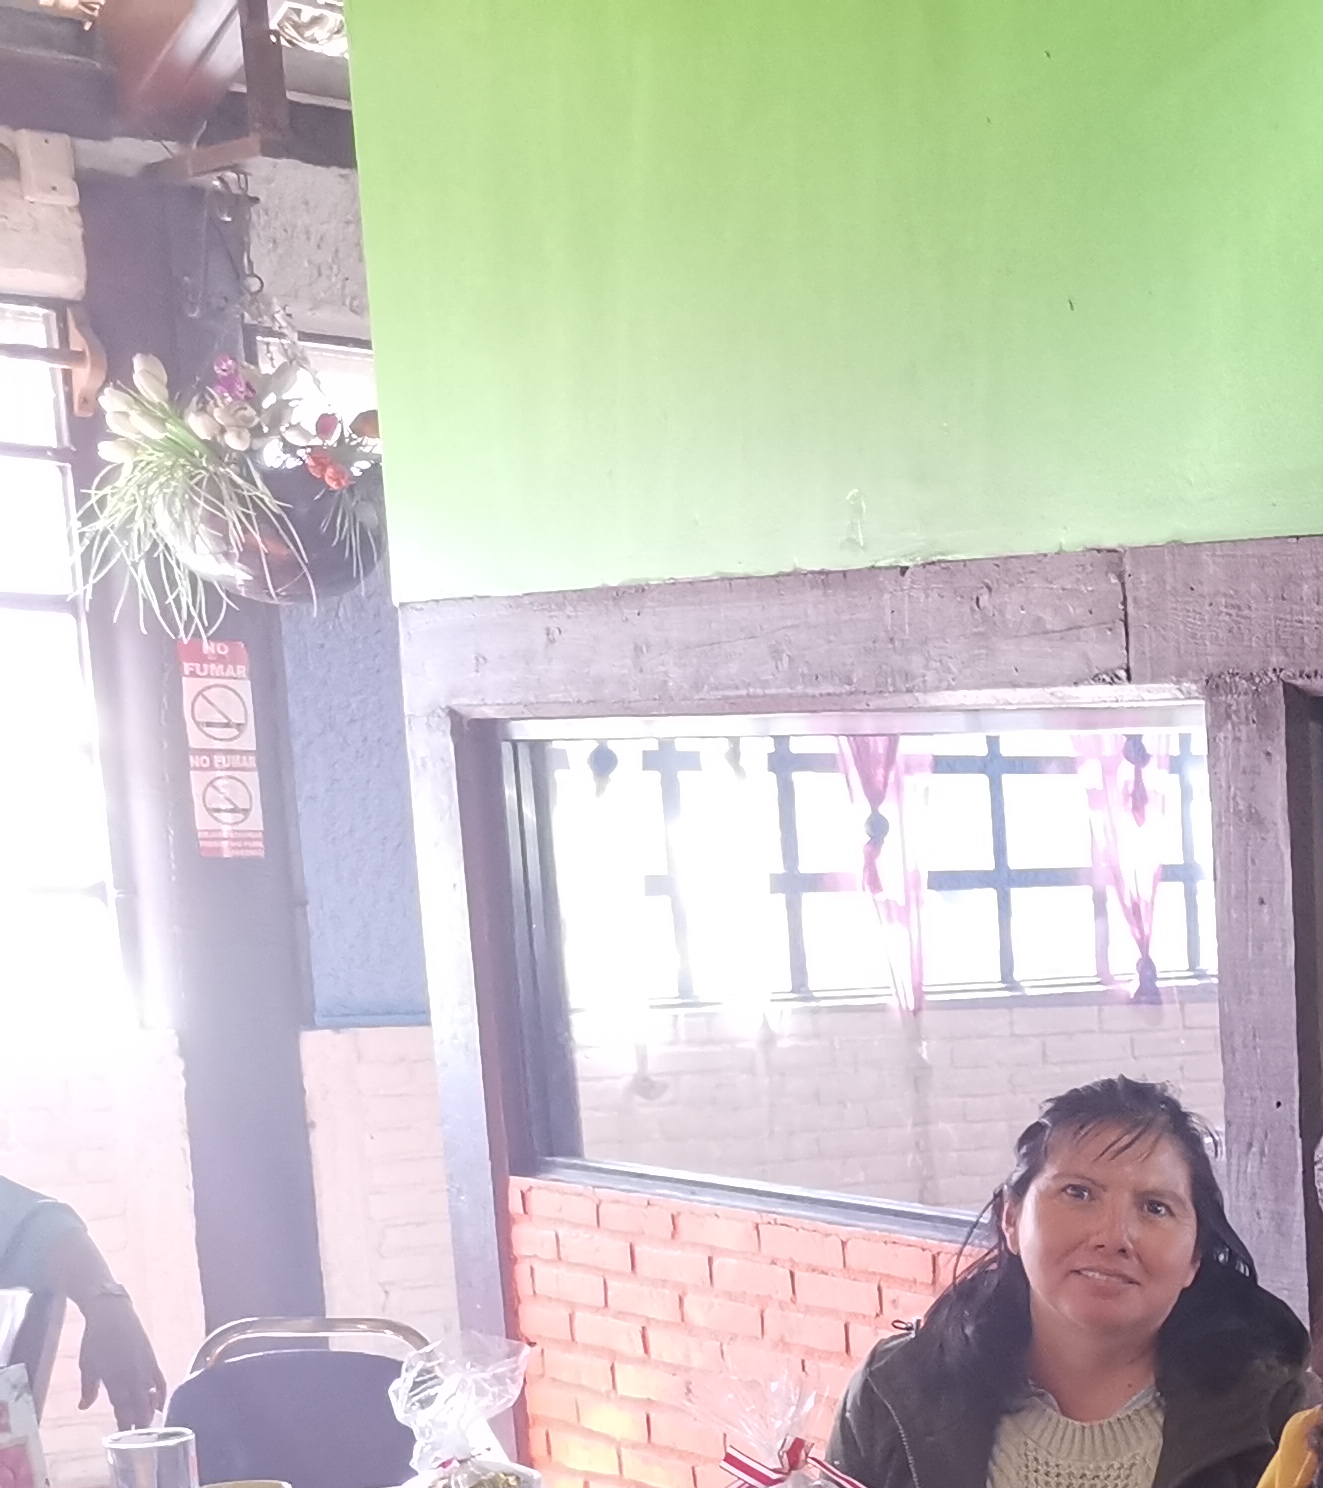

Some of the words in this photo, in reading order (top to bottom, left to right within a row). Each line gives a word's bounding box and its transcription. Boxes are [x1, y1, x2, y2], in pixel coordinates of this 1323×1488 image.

[202, 642, 229, 655] NO
[182, 662, 247, 678] FUMAR
[189, 754, 210, 768] NO
[213, 754, 256, 768] FUMAR
